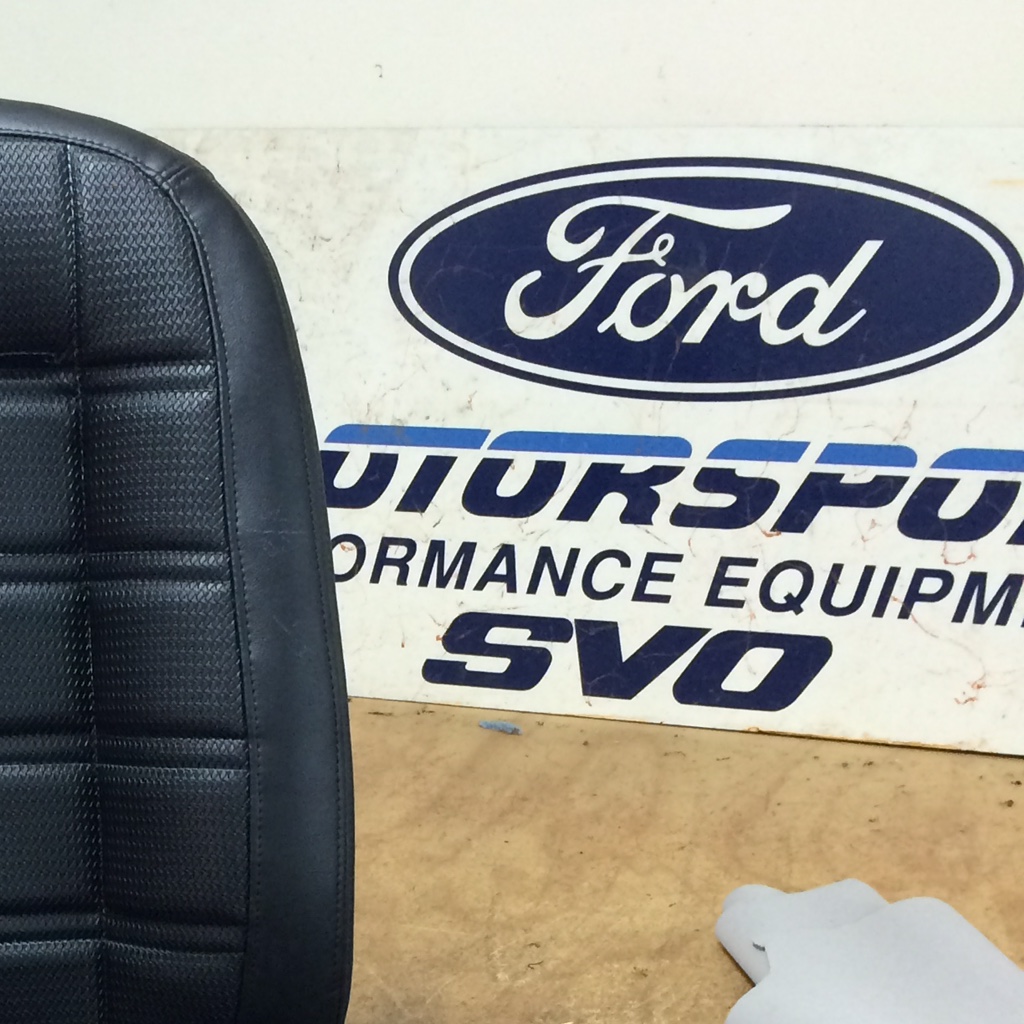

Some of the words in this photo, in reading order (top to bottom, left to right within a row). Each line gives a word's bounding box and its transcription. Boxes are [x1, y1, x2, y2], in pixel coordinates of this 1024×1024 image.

[504, 195, 884, 347] Ford
[320, 424, 1024, 547] OTORSPO
[331, 534, 683, 604] ORMANCE
[704, 557, 1024, 629] EQUIPM
[422, 611, 833, 711] SVO
